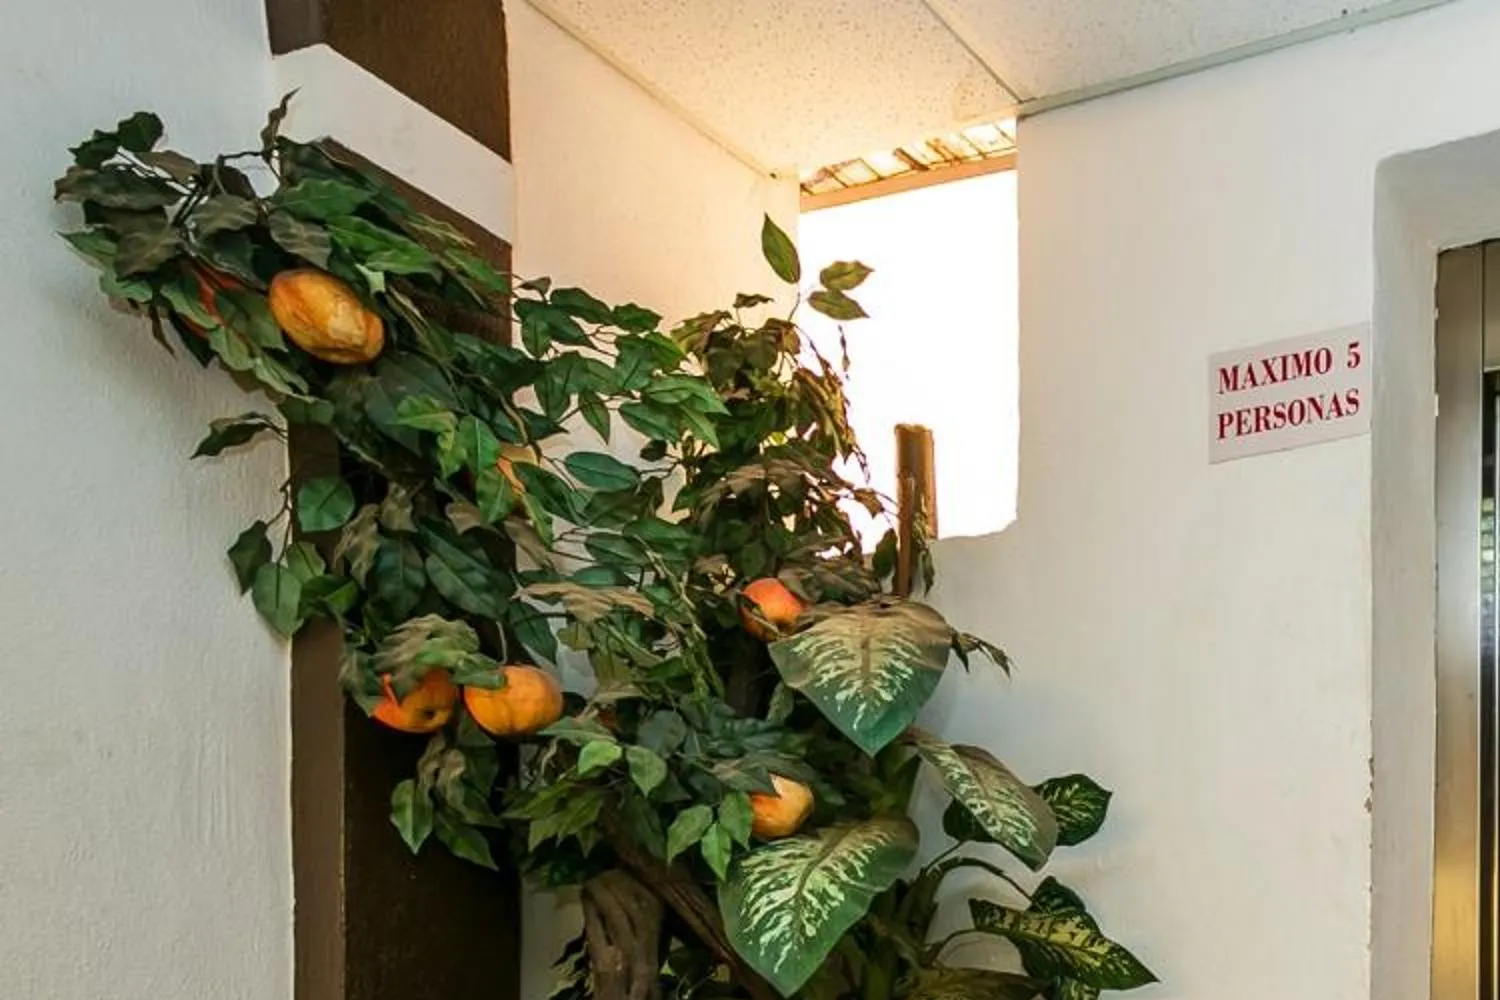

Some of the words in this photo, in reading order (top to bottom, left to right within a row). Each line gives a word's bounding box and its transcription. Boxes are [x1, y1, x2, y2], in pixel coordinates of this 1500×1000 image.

[1218, 347, 1333, 395] MAXIMO
[1346, 341, 1361, 369] 5
[1217, 388, 1360, 441] PERSONAS
